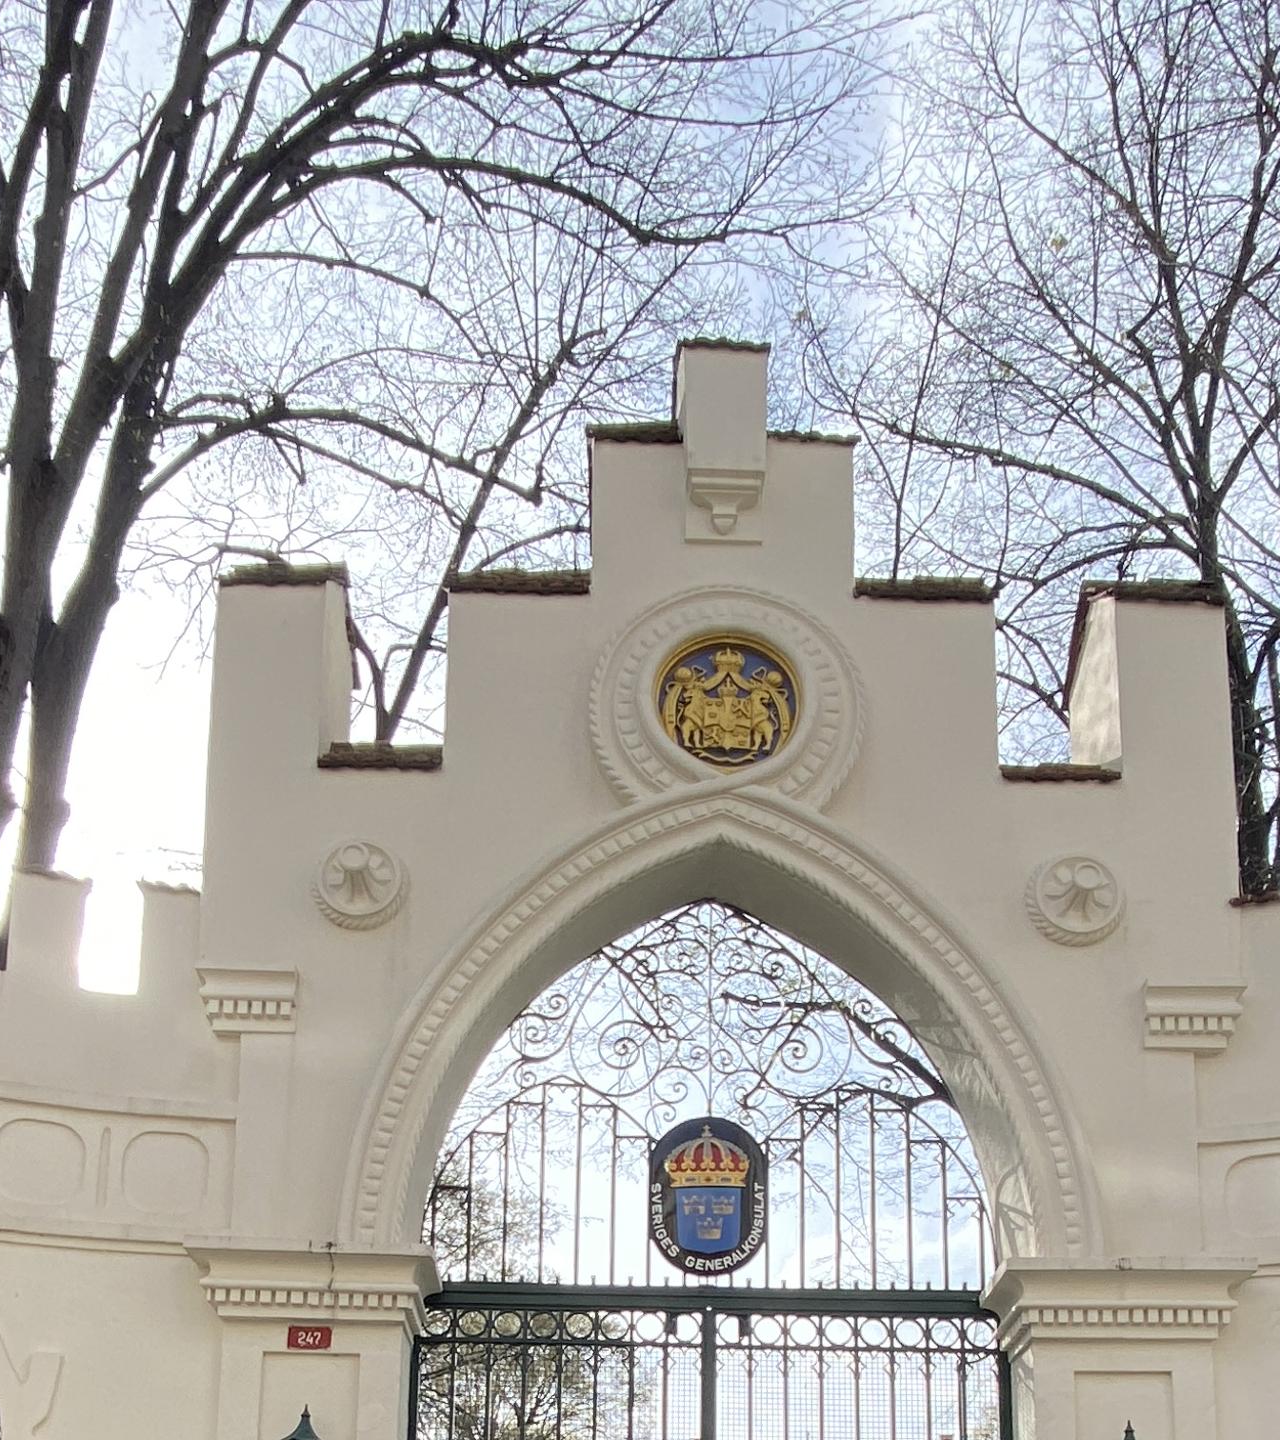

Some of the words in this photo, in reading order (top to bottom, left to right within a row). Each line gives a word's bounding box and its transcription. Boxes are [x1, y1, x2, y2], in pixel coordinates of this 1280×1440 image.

[651, 1183, 680, 1258] SVERIGES
[685, 1183, 765, 1271] GENERALKONSULAT
[297, 1331, 322, 1346] 247
